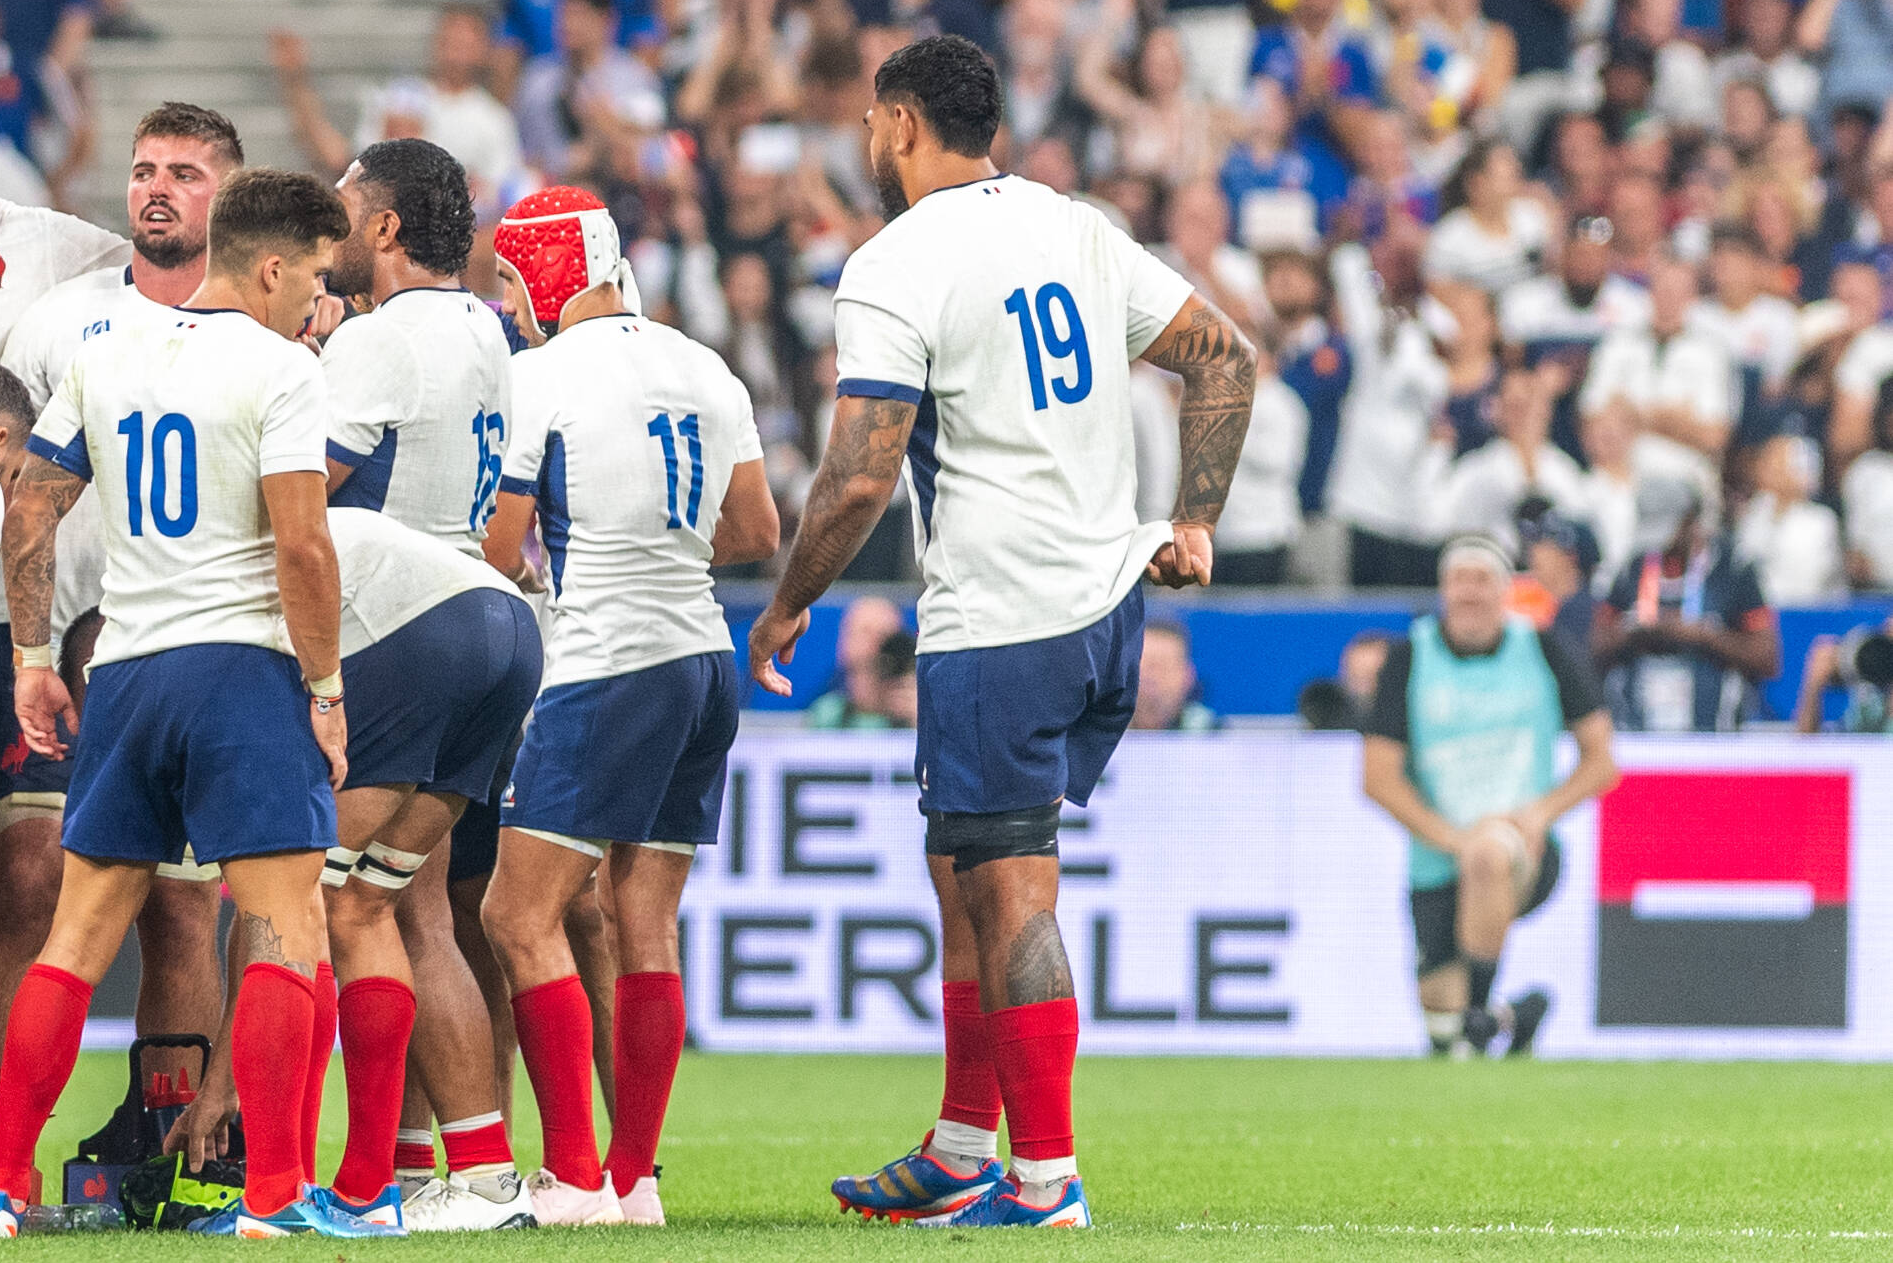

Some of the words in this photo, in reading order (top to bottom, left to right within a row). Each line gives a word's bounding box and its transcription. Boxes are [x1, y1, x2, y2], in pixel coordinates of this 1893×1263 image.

[1004, 282, 1093, 411] 19
[117, 411, 198, 538] 10
[647, 413, 703, 528] 11
